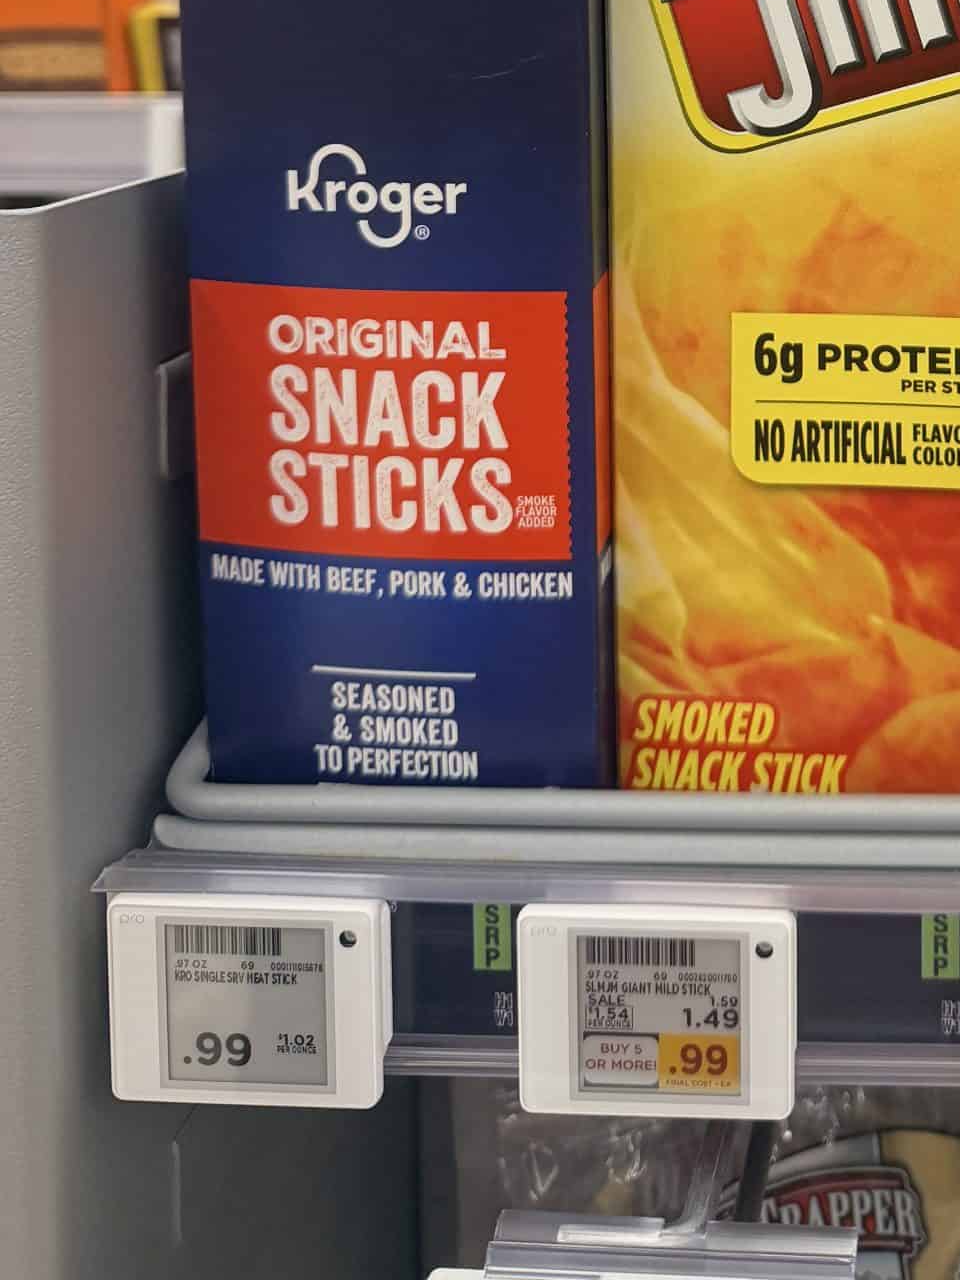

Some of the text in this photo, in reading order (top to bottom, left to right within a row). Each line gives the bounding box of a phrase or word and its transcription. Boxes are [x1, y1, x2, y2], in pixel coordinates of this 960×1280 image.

[287, 143, 467, 248] Kroger
[268, 314, 507, 360] ORIGINAL
[754, 333, 804, 383] 6g
[901, 379, 937, 394] PER
[269, 363, 510, 450] SNACK
[754, 418, 785, 462] NO
[791, 419, 907, 465] ARTIFICIAL
[268, 448, 514, 533] STICKS
[517, 495, 555, 506] SMOKE
[515, 505, 558, 517] FLAVOR
[518, 516, 555, 528] ADDED
[211, 553, 573, 599] MADE WITH BEEF, PORK & CHICKEN
[331, 681, 456, 714] SEASONED
[333, 713, 459, 747] & SMOKED
[633, 698, 776, 745] SMOKED
[313, 743, 479, 779] TO PERFECTION
[633, 748, 848, 795] SNACK STICK
[485, 904, 500, 968] SRP
[933, 914, 948, 977] SRP
[194, 971, 226, 983] SINGLE
[272, 973, 298, 985] STICK
[605, 970, 619, 980] OZ
[621, 981, 653, 994] GIANT
[655, 982, 679, 995] MILD
[682, 983, 711, 996] STICK
[588, 994, 626, 1006] SALE
[683, 1007, 739, 1029] 1.49
[183, 1032, 252, 1066] .99
[584, 1059, 606, 1071] OR
[600, 1043, 643, 1055] BUY 5
[668, 1043, 728, 1076] .99
